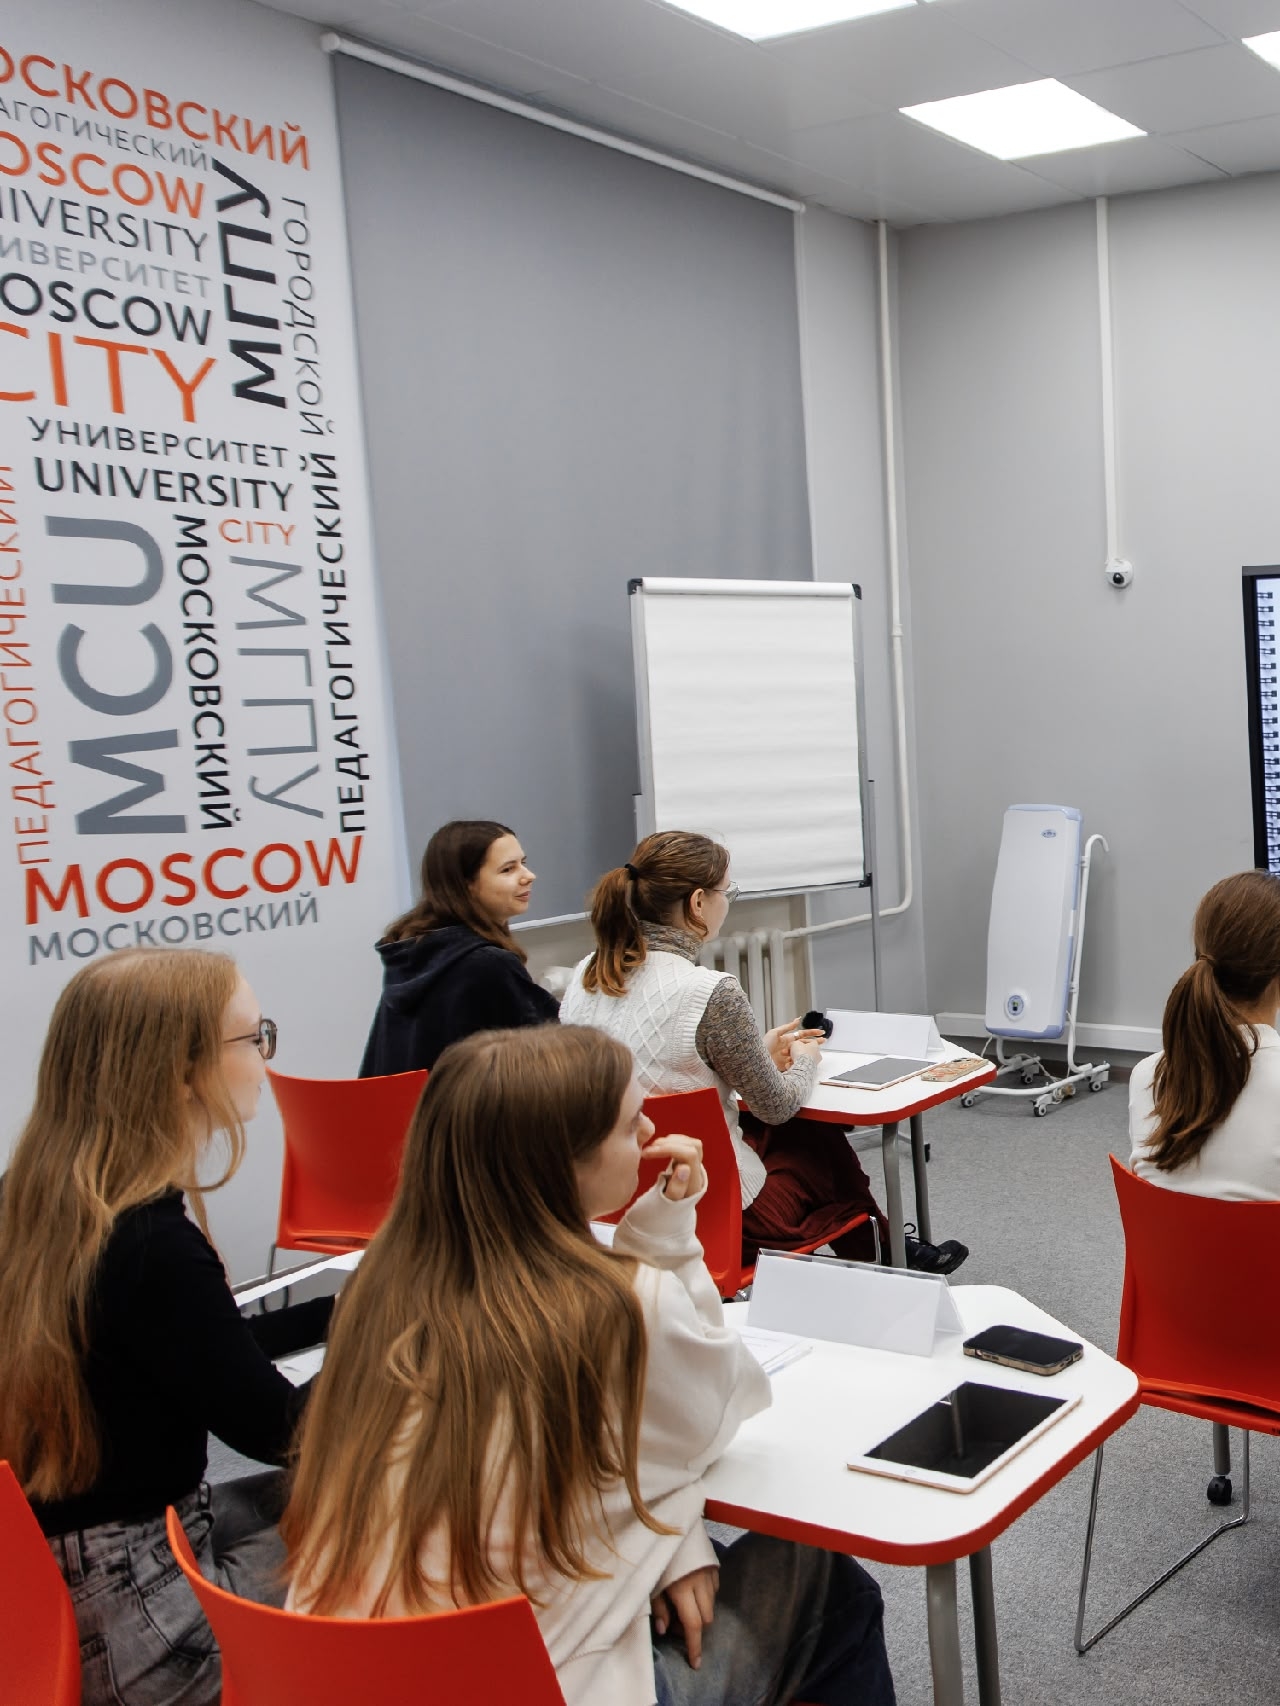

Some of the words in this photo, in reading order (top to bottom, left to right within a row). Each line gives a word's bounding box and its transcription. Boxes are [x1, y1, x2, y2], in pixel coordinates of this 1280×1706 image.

[0, 185, 208, 263] IVERSITY
[0, 272, 213, 345] OSCOW
[211, 157, 287, 409] МГПУ
[282, 196, 335, 435] ГОРОДСКОЙ
[27, 414, 290, 469] УНИВЕРСИТЕТ
[34, 456, 294, 512] UNIVERSITY
[218, 518, 297, 547] CITY
[45, 514, 188, 835] MCU
[172, 513, 241, 830] МОСКОВСКИЙ
[229, 555, 324, 820] МГПУ
[300, 452, 370, 834] ПЕДАГОГИЧЕСКИЙ
[25, 834, 364, 926] MOSCOW
[28, 891, 320, 966] МОСКОВСКИЙ
